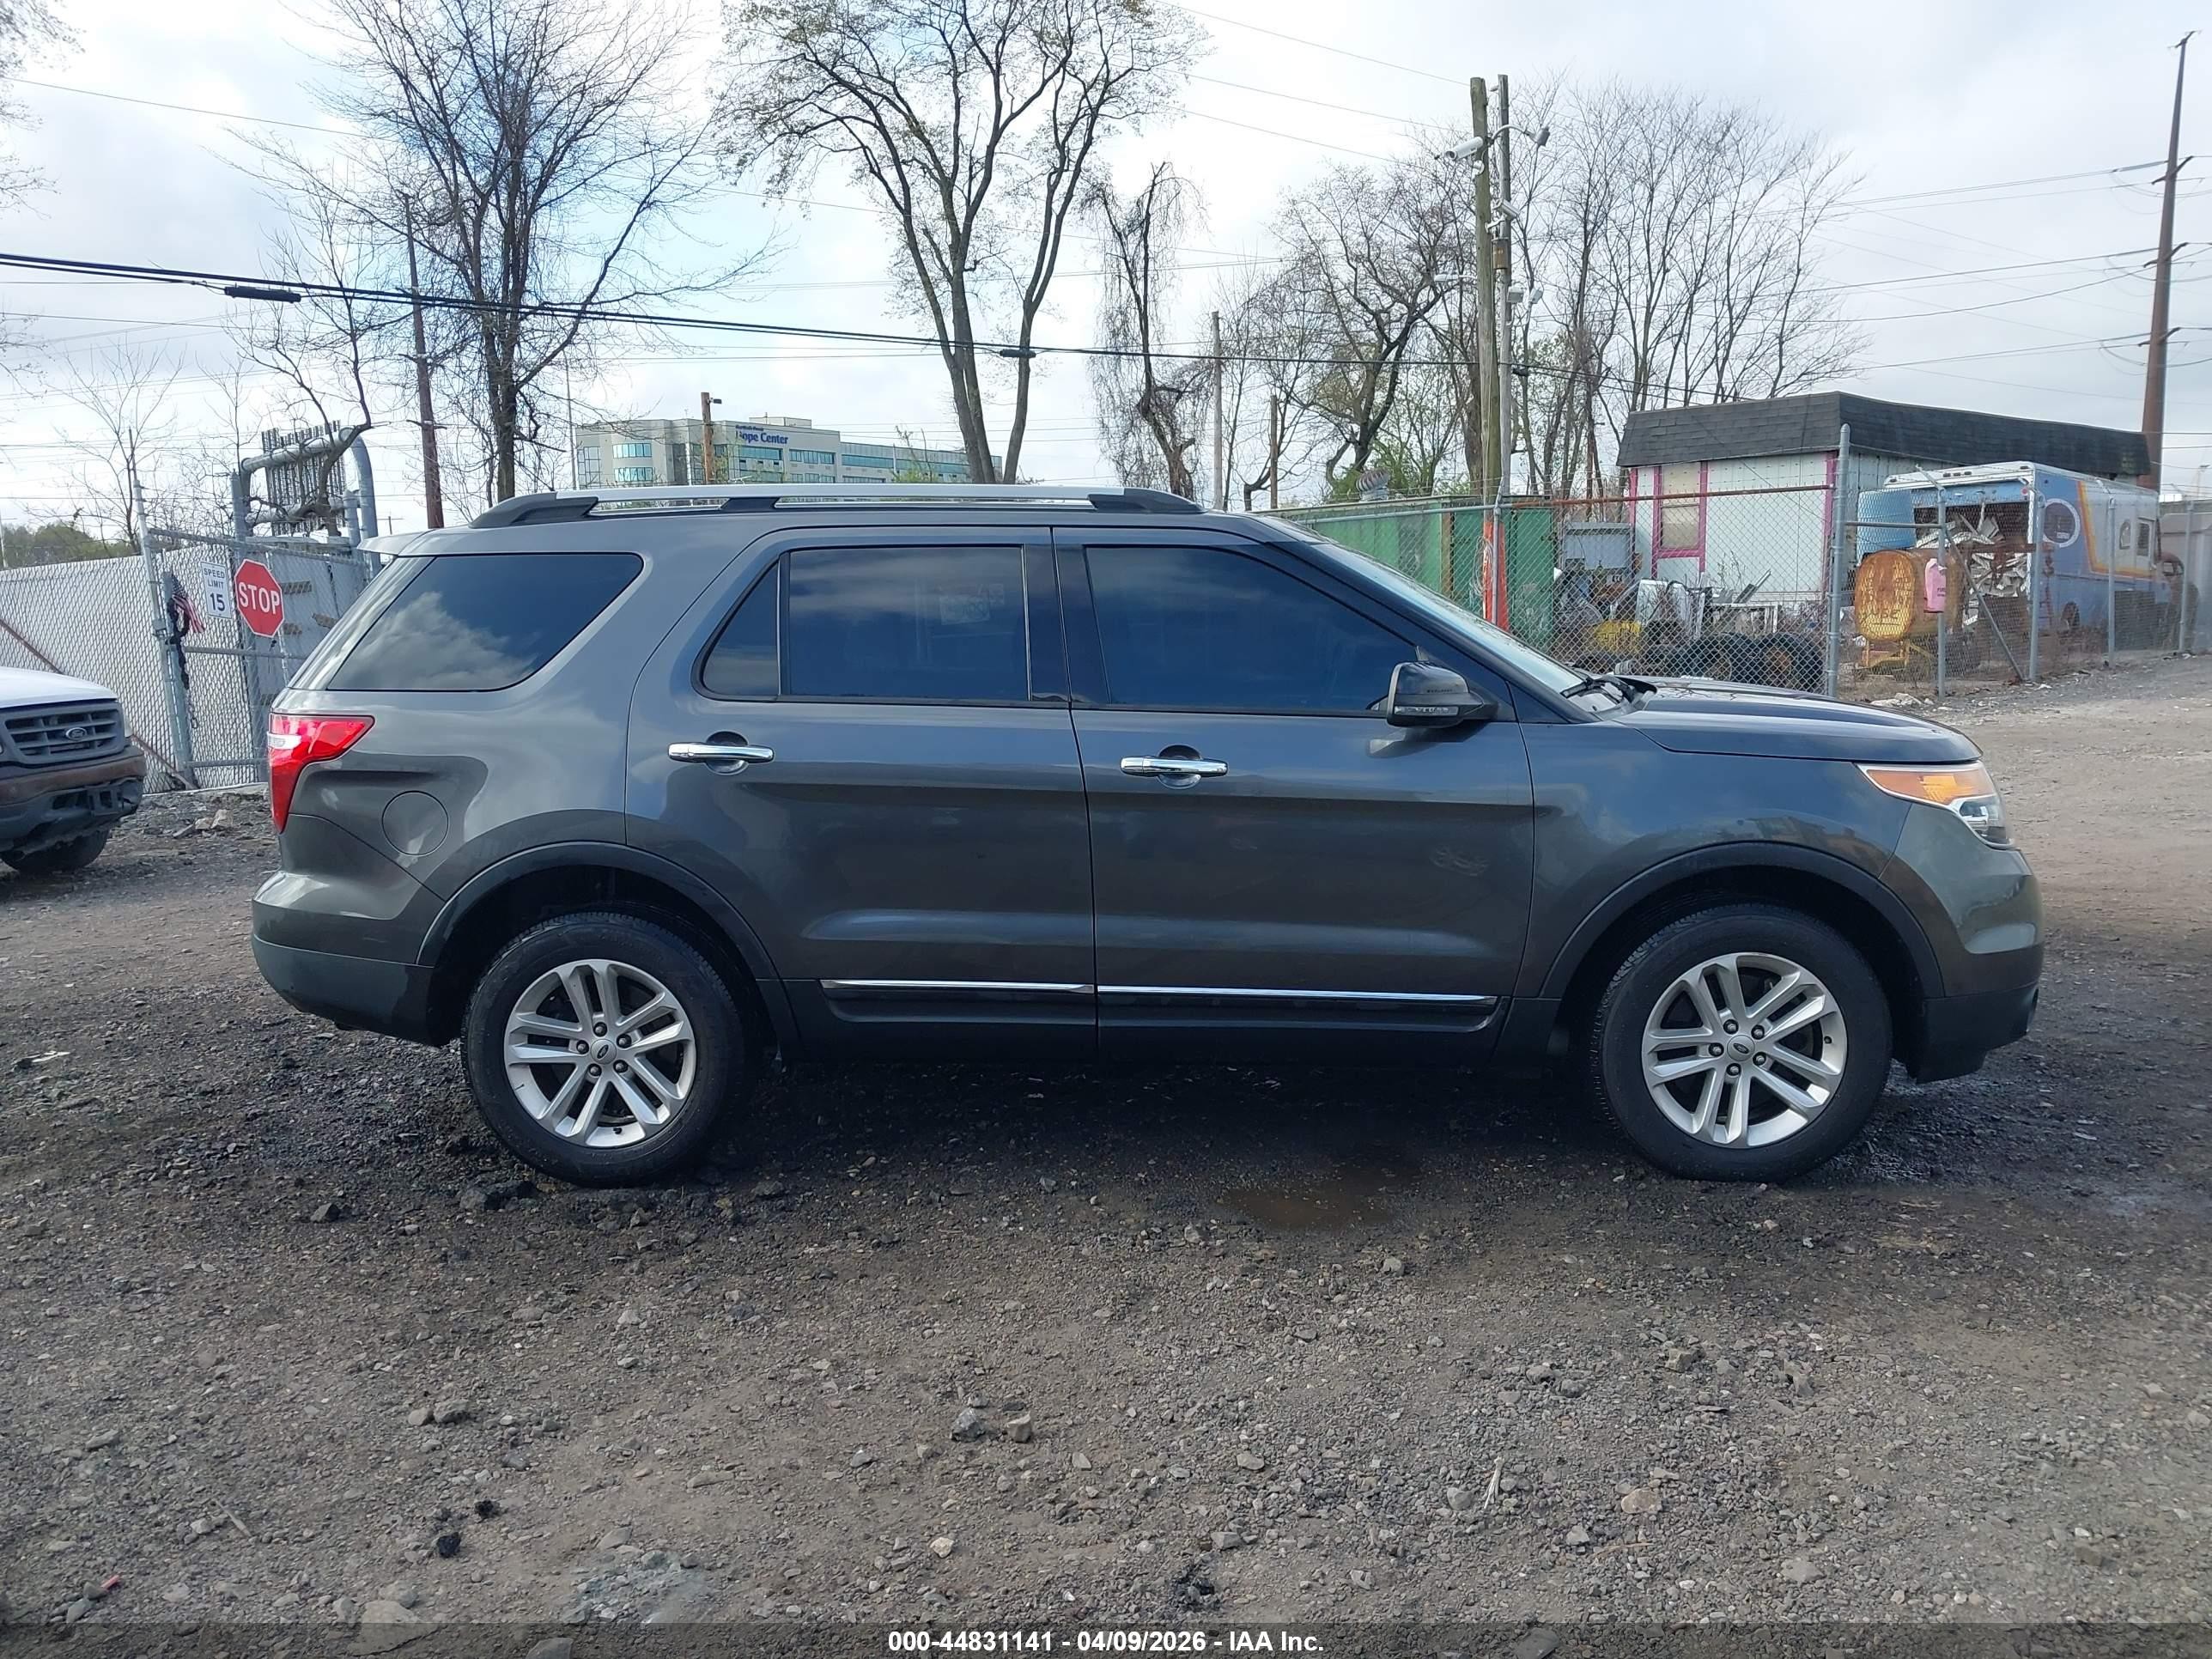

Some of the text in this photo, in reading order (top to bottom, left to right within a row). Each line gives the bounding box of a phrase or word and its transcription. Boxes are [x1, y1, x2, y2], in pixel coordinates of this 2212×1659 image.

[761, 433, 789, 444] Center
[204, 568, 225, 579] SPEED
[208, 579, 224, 589] LIMIT
[210, 592, 226, 611] 15
[239, 582, 280, 615] STOP
